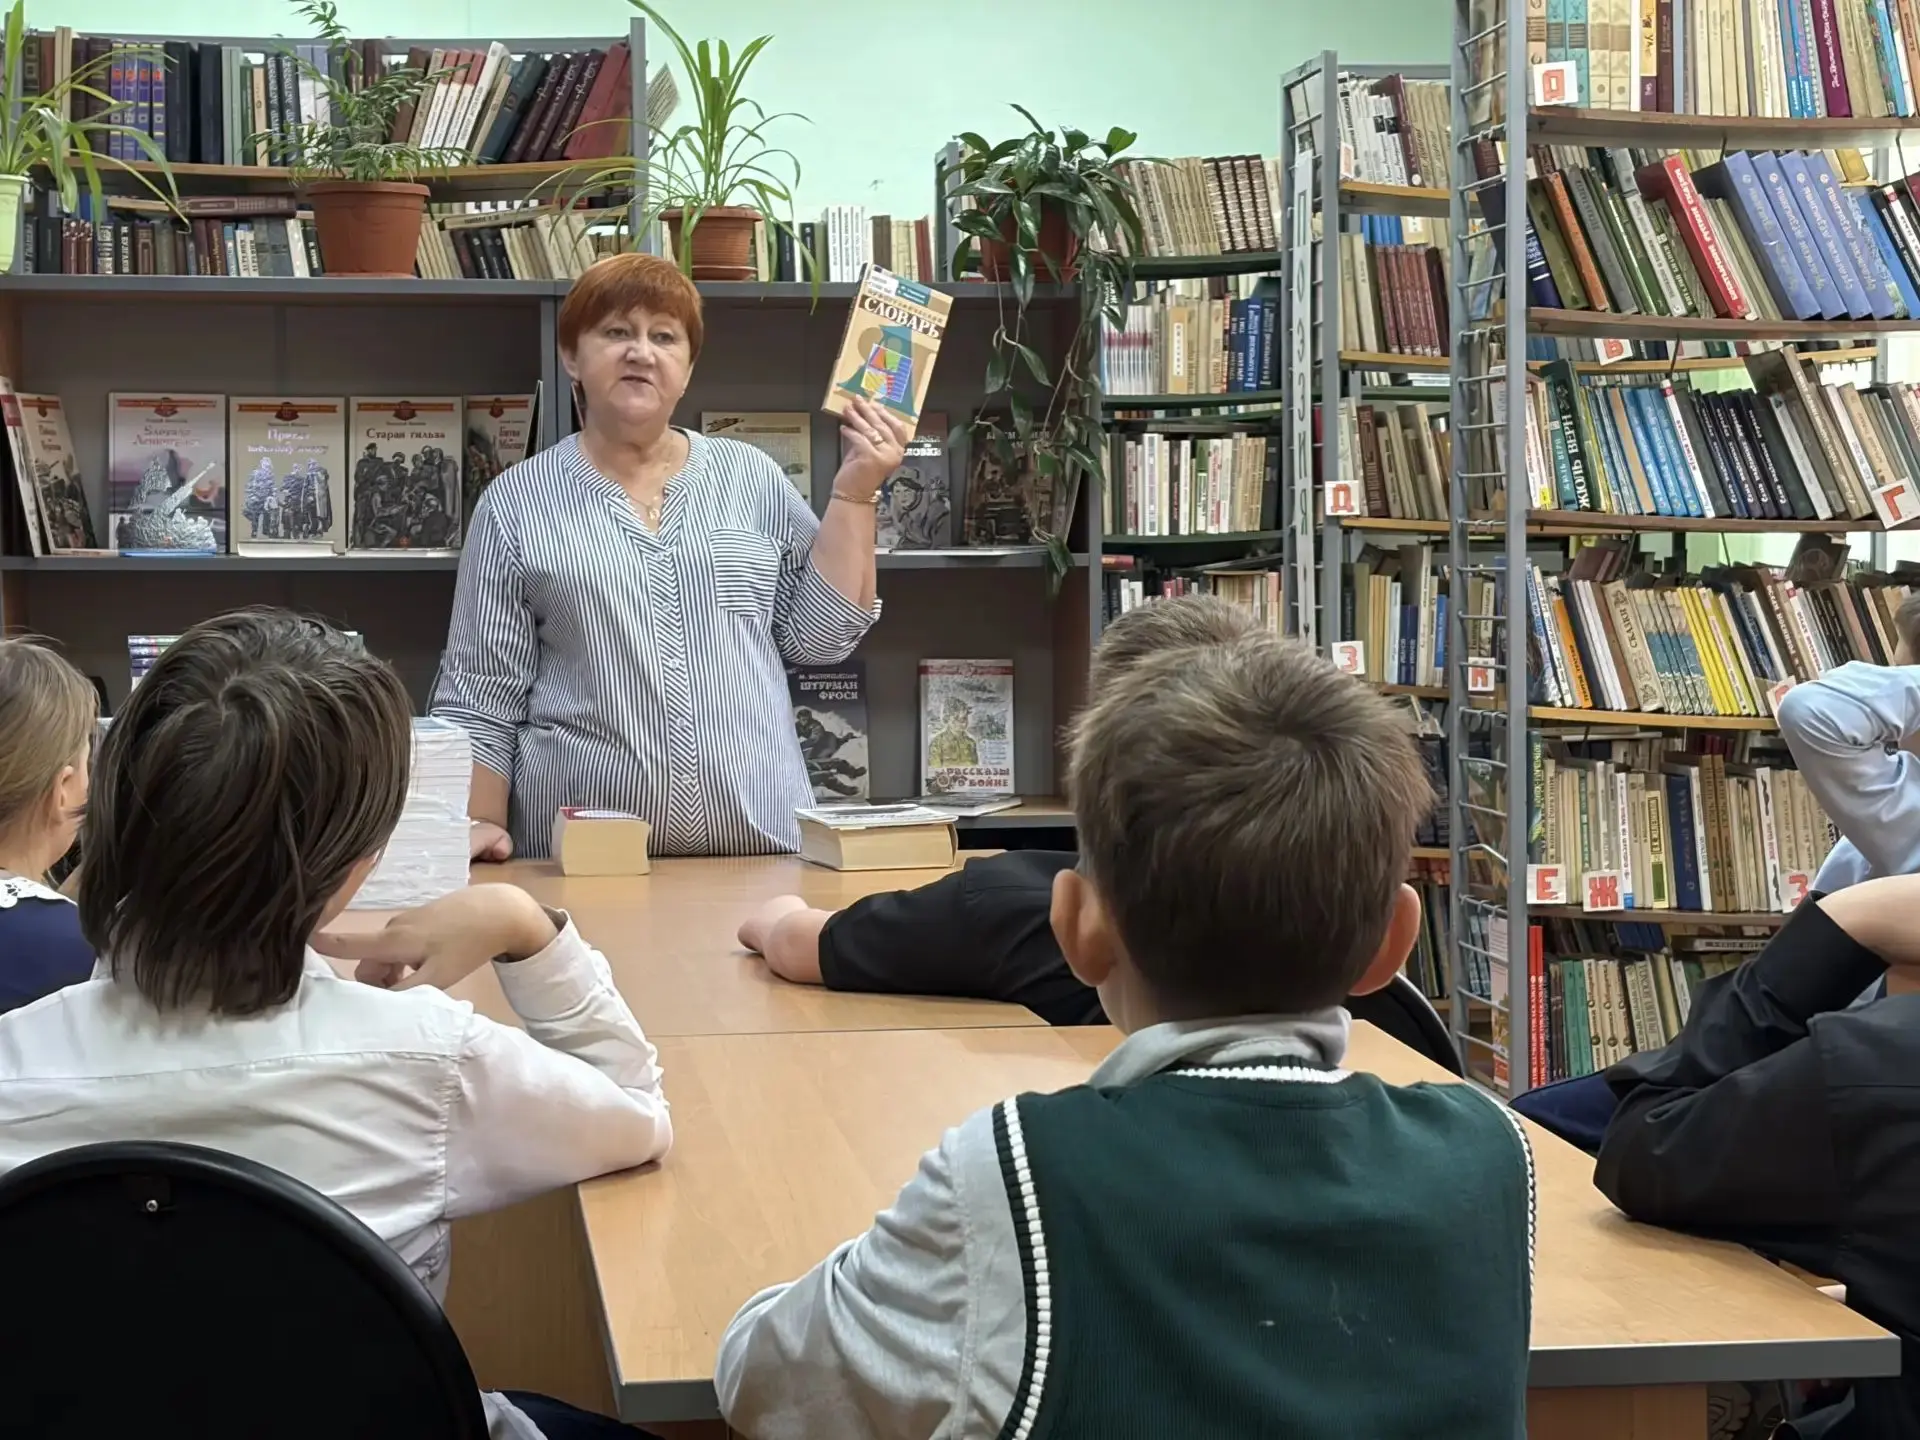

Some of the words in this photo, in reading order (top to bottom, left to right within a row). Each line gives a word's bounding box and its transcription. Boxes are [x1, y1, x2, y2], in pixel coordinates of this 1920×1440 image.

[865, 296, 940, 339] СЛОВАРЬ
[366, 428, 405, 440] Старая
[410, 431, 445, 439] гильза
[1553, 437, 1564, 460] ВЕРН
[1560, 414, 1578, 454] ВЕРН
[1559, 462, 1570, 491] ЖЮЛЬ
[1569, 458, 1590, 509] ЖЮЛЬ
[1331, 484, 1354, 513] Д
[1882, 485, 1905, 521] Г
[1765, 583, 1780, 611] КРУЗО
[1618, 607, 1639, 649] СКАЗКИ
[1775, 611, 1796, 655] РОБИНЗОН
[1340, 646, 1358, 671] З
[800, 681, 858, 690] ШТУРМАН
[947, 767, 1010, 776] РАССКАЗЫ
[969, 776, 1009, 787] ВОЙНЕ
[1536, 869, 1559, 901] Е
[1589, 876, 1618, 907] Ж
[1789, 874, 1808, 906] З
